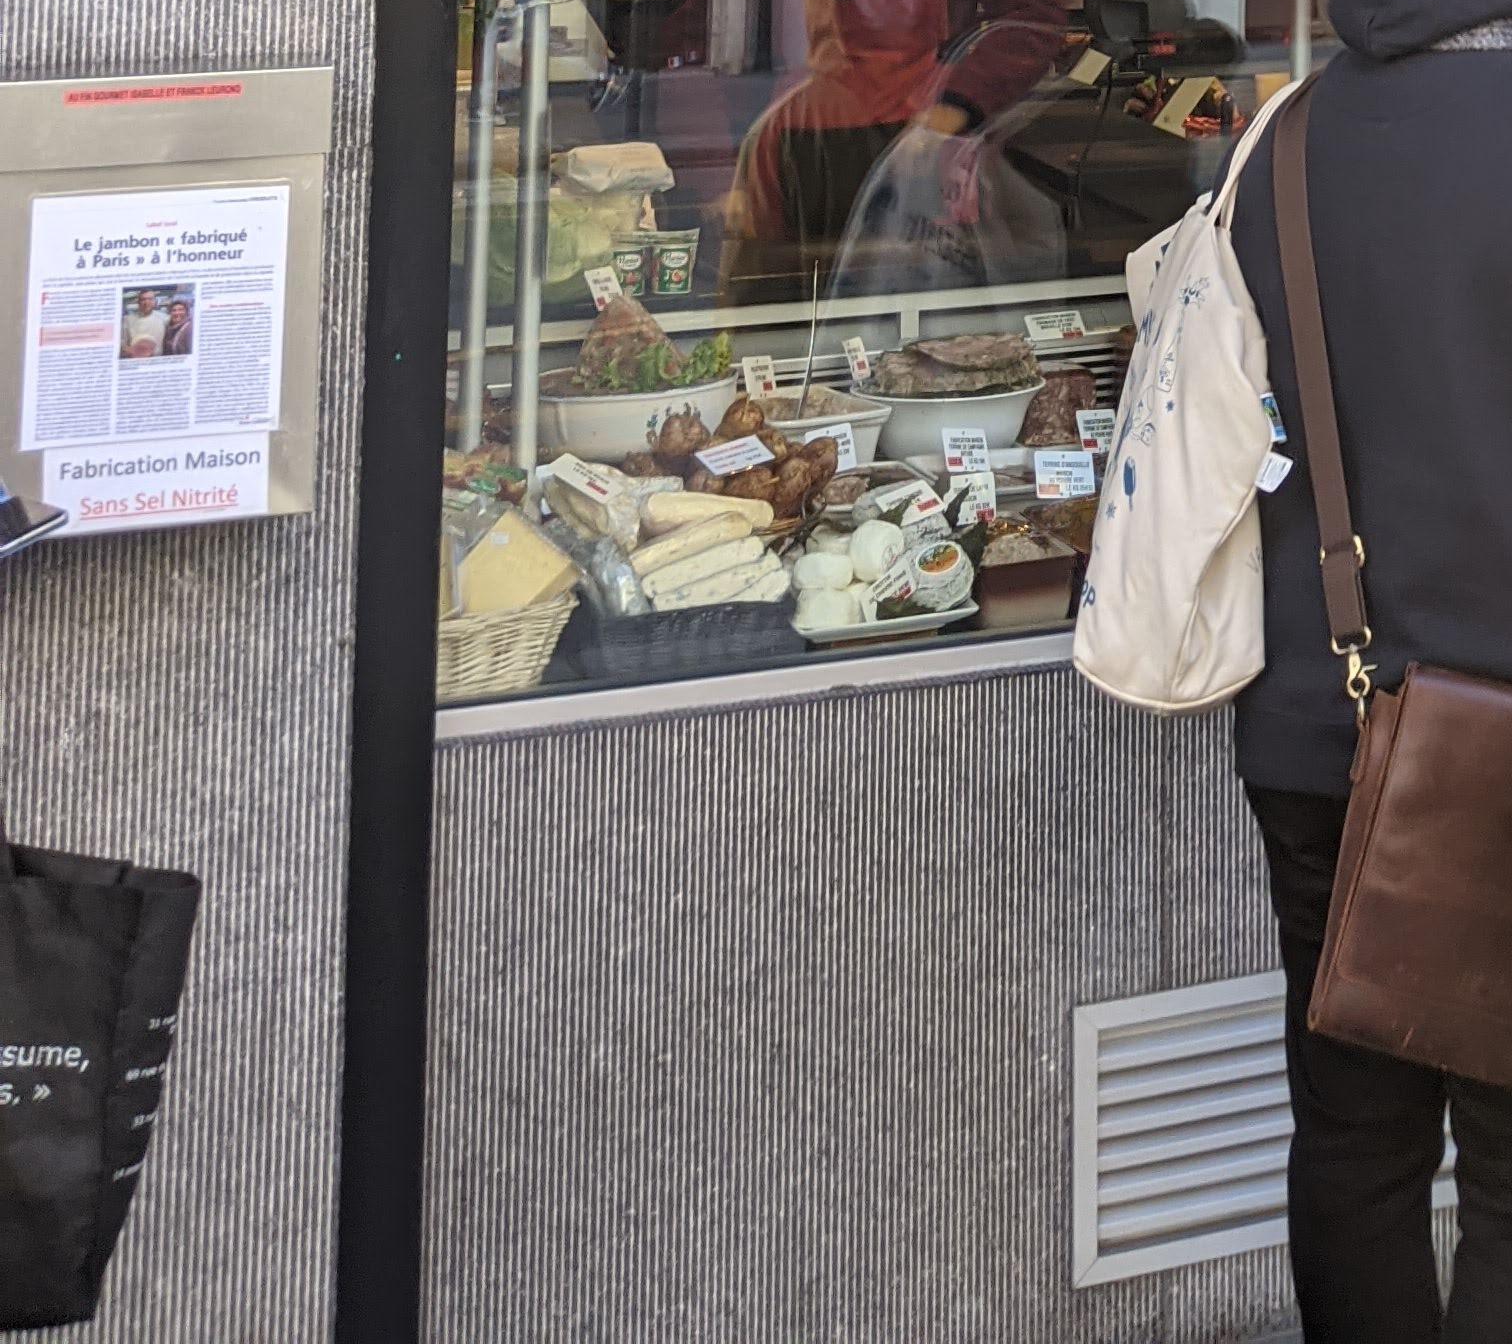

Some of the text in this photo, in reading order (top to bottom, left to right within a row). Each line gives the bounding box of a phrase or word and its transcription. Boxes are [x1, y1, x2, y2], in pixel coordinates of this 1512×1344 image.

[74, 238, 92, 252] Le
[97, 234, 160, 254] jambon
[180, 227, 248, 248] fabriqué
[75, 255, 86, 269] à
[92, 251, 130, 268] Paris
[150, 251, 161, 265] à
[58, 448, 261, 481] Fabrication Maison
[79, 484, 239, 516] Sans Sel Nitrité
[0, 1045, 90, 1073] sume,
